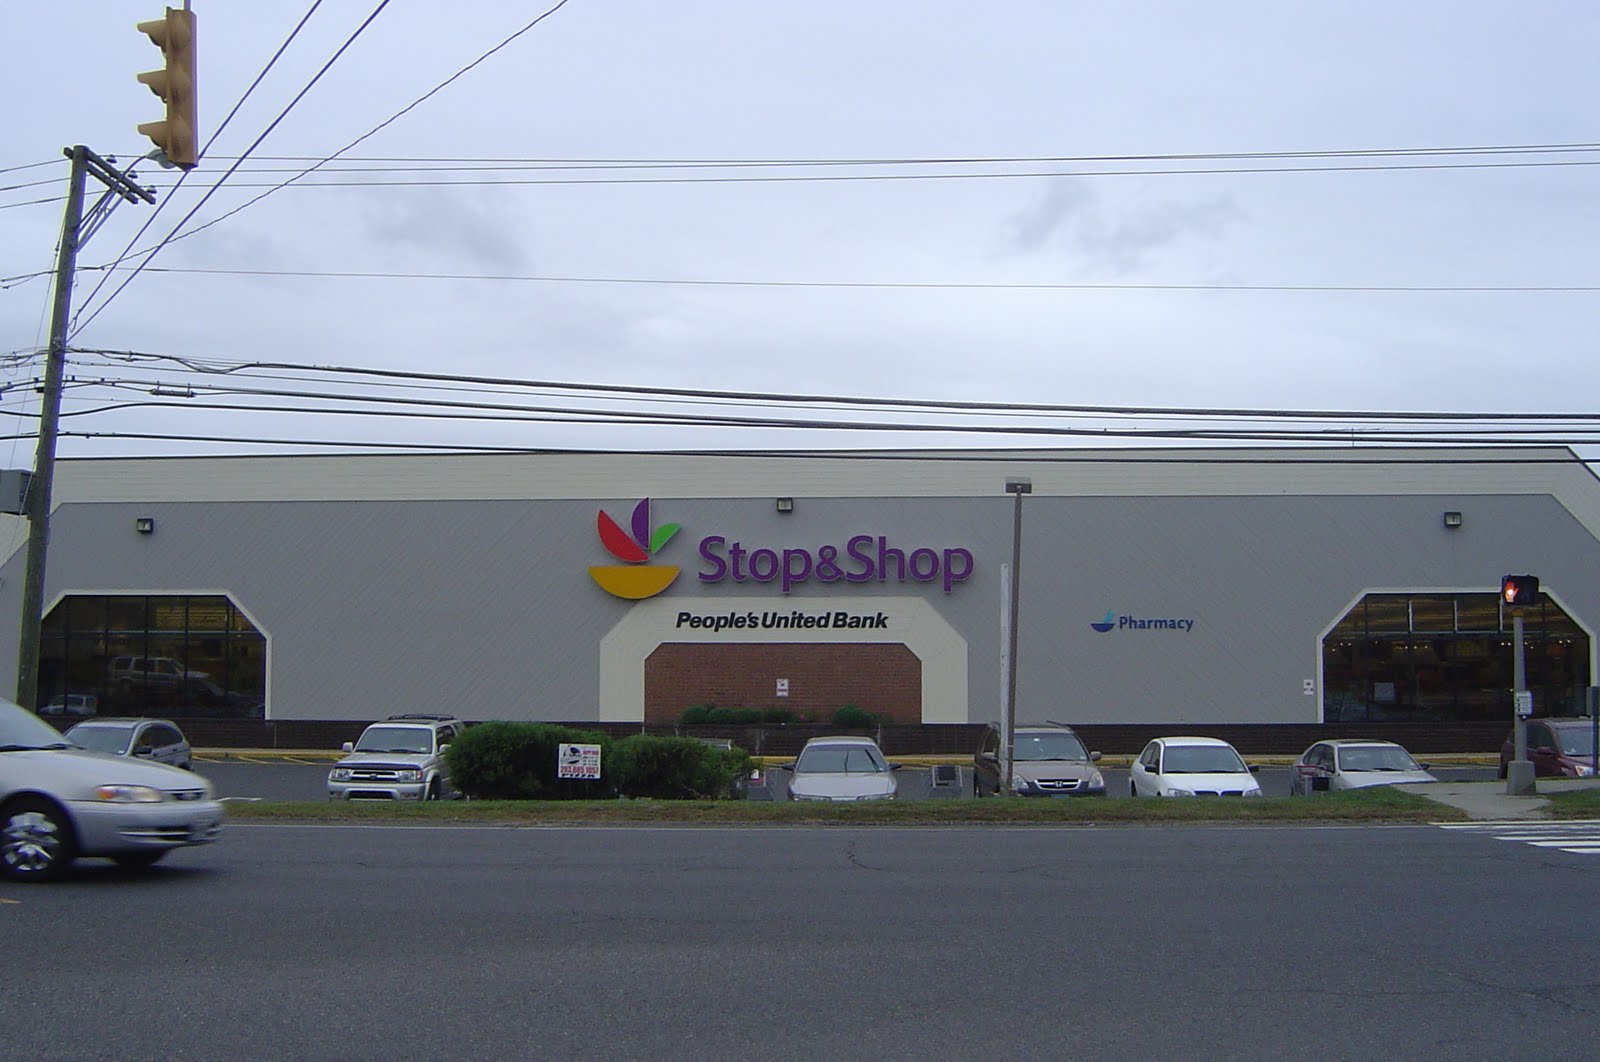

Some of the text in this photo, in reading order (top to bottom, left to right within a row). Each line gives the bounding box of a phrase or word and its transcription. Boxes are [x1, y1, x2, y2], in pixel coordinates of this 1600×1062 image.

[698, 535, 974, 592] Stop&Shop
[676, 611, 888, 632] People's United Bank
[1119, 615, 1194, 632] Pharmacy
